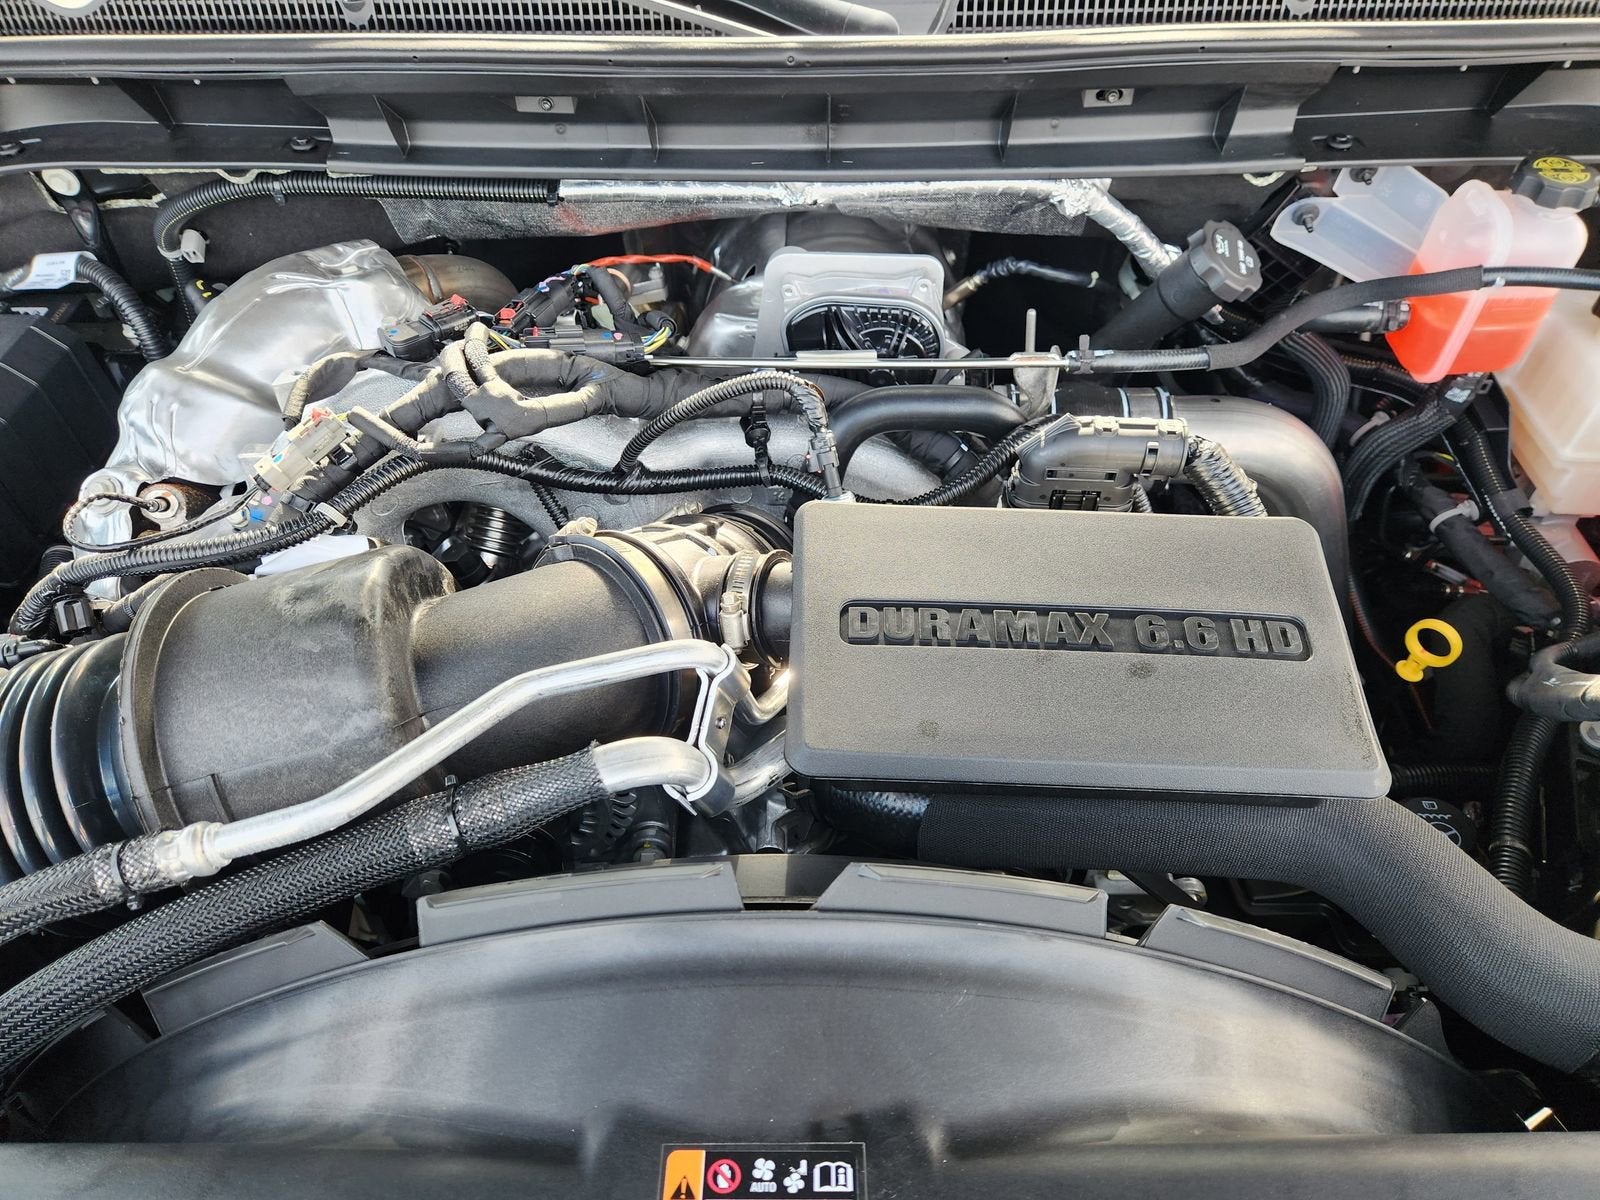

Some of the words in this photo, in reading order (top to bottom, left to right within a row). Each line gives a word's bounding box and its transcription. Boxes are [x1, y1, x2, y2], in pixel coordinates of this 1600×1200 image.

[848, 606, 1115, 646] DURAMAX
[1134, 614, 1220, 650] 6.6
[1230, 618, 1304, 654] HD
[749, 1181, 778, 1193] AUTO
